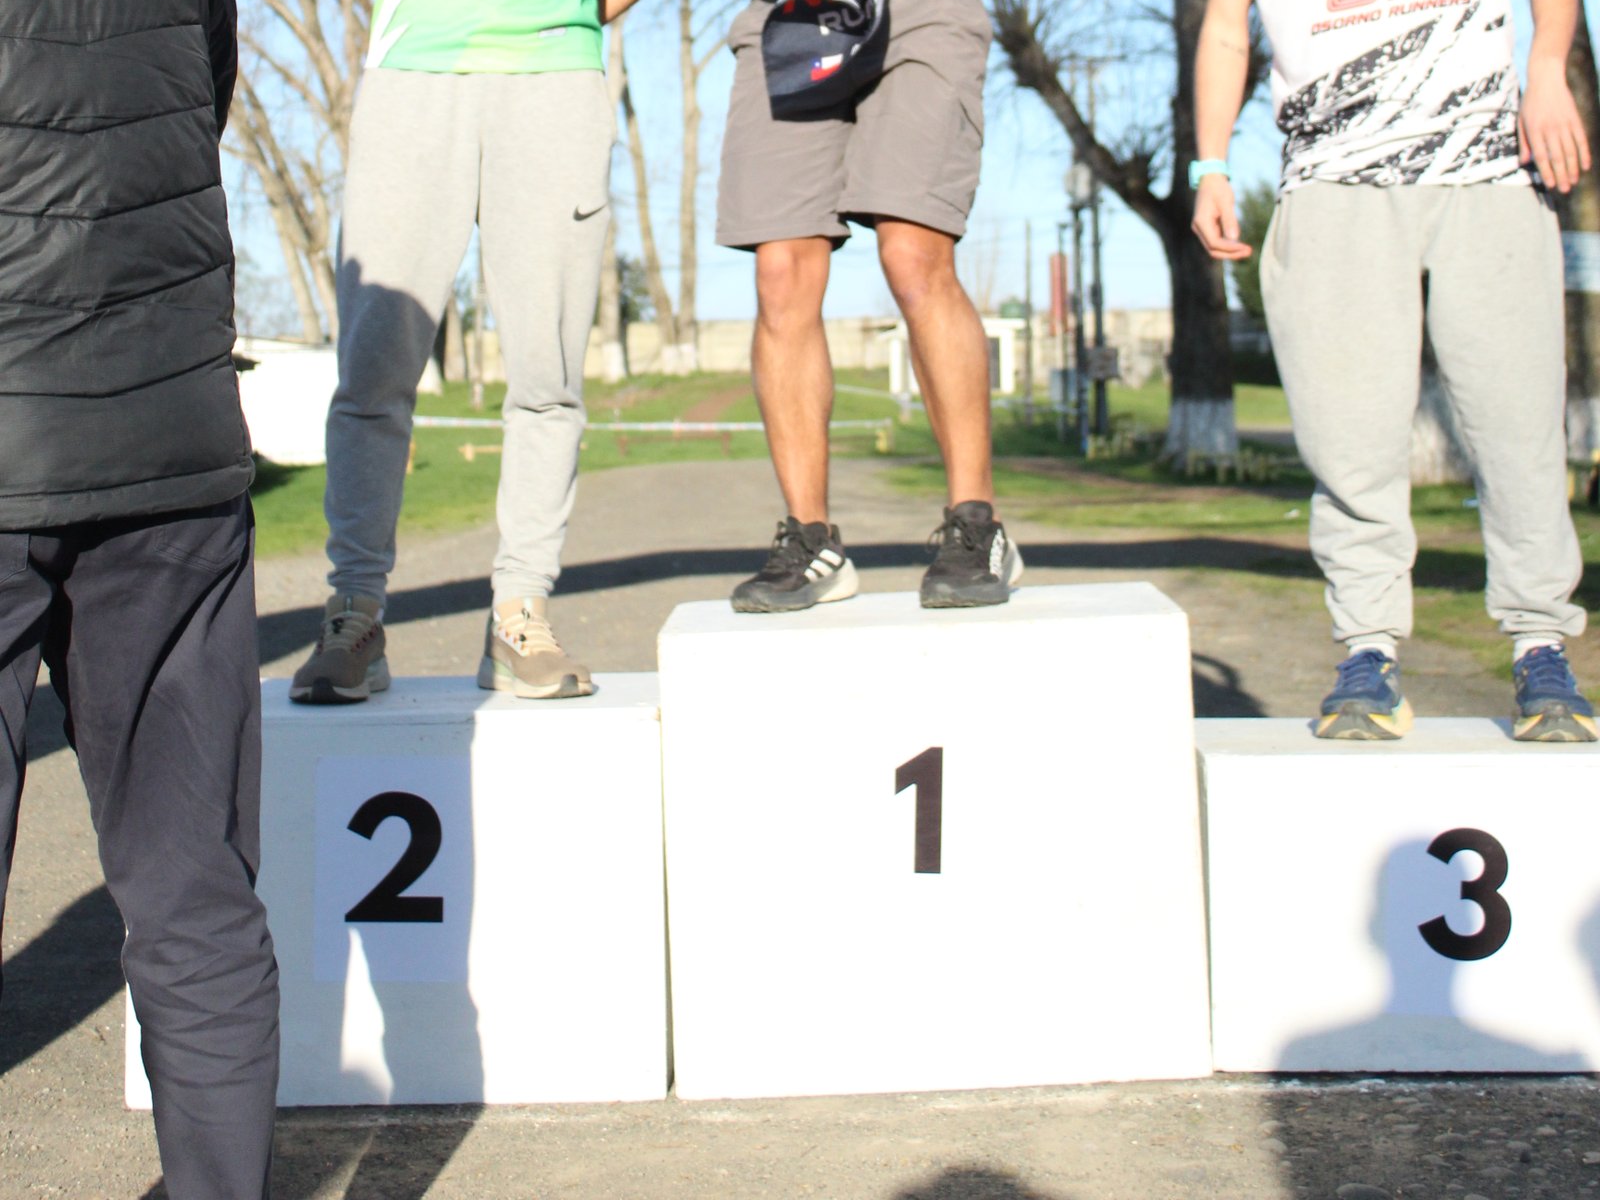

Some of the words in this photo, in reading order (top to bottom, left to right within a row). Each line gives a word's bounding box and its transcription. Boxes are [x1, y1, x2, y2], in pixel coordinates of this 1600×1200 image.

[1311, 9, 1382, 35] OSORNO
[343, 790, 444, 924] 2
[895, 746, 943, 874] 1
[1417, 828, 1512, 962] 3
